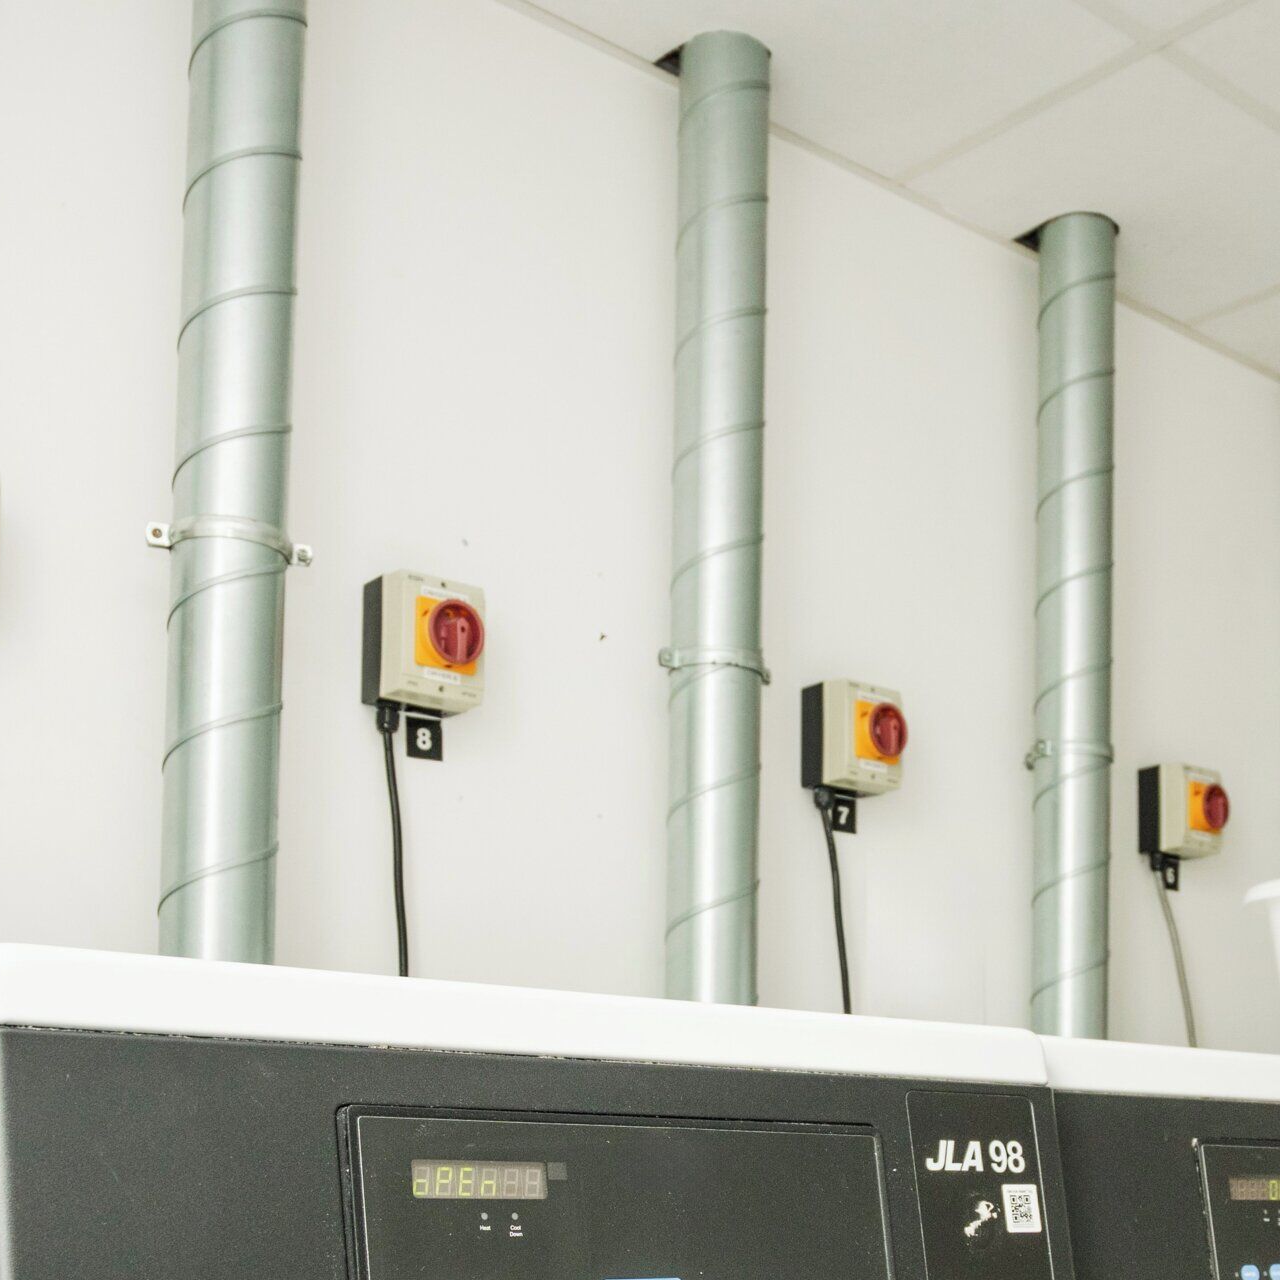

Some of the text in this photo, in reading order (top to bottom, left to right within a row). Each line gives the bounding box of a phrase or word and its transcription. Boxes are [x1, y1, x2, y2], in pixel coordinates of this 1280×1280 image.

[416, 727, 432, 750] 8
[837, 806, 850, 825] 7
[926, 1139, 1026, 1173] JLA 98
